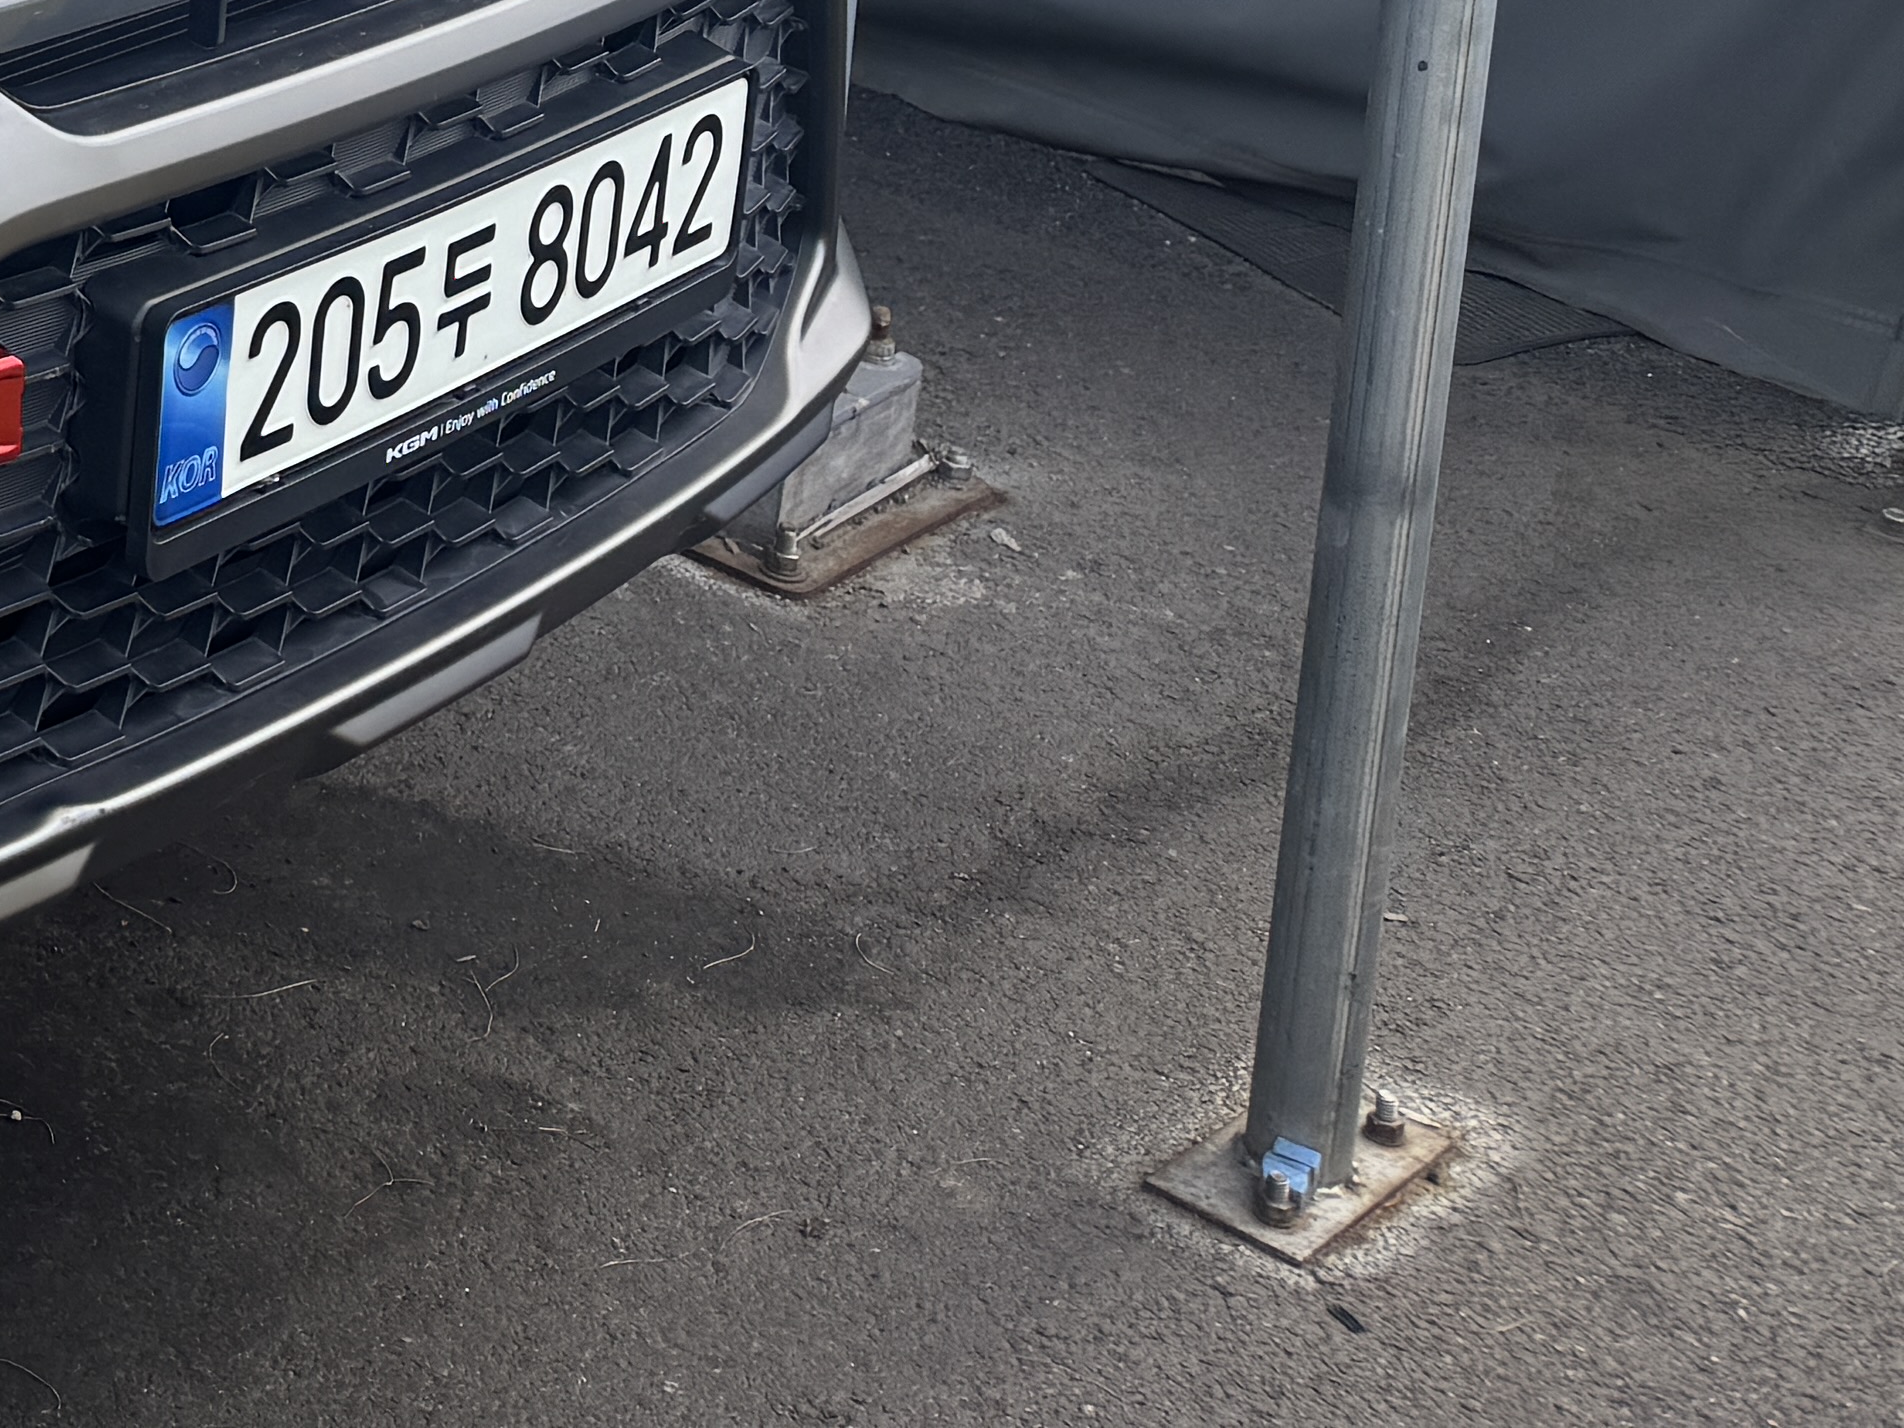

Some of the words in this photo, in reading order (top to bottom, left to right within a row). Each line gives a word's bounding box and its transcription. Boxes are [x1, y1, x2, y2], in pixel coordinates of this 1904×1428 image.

[238, 222, 498, 463] 205두
[518, 113, 726, 328] 8042
[385, 425, 439, 464] KGM
[445, 410, 475, 435] Enjoy
[476, 398, 499, 419] with
[500, 370, 556, 407] Confidence
[158, 445, 219, 505] KOR
